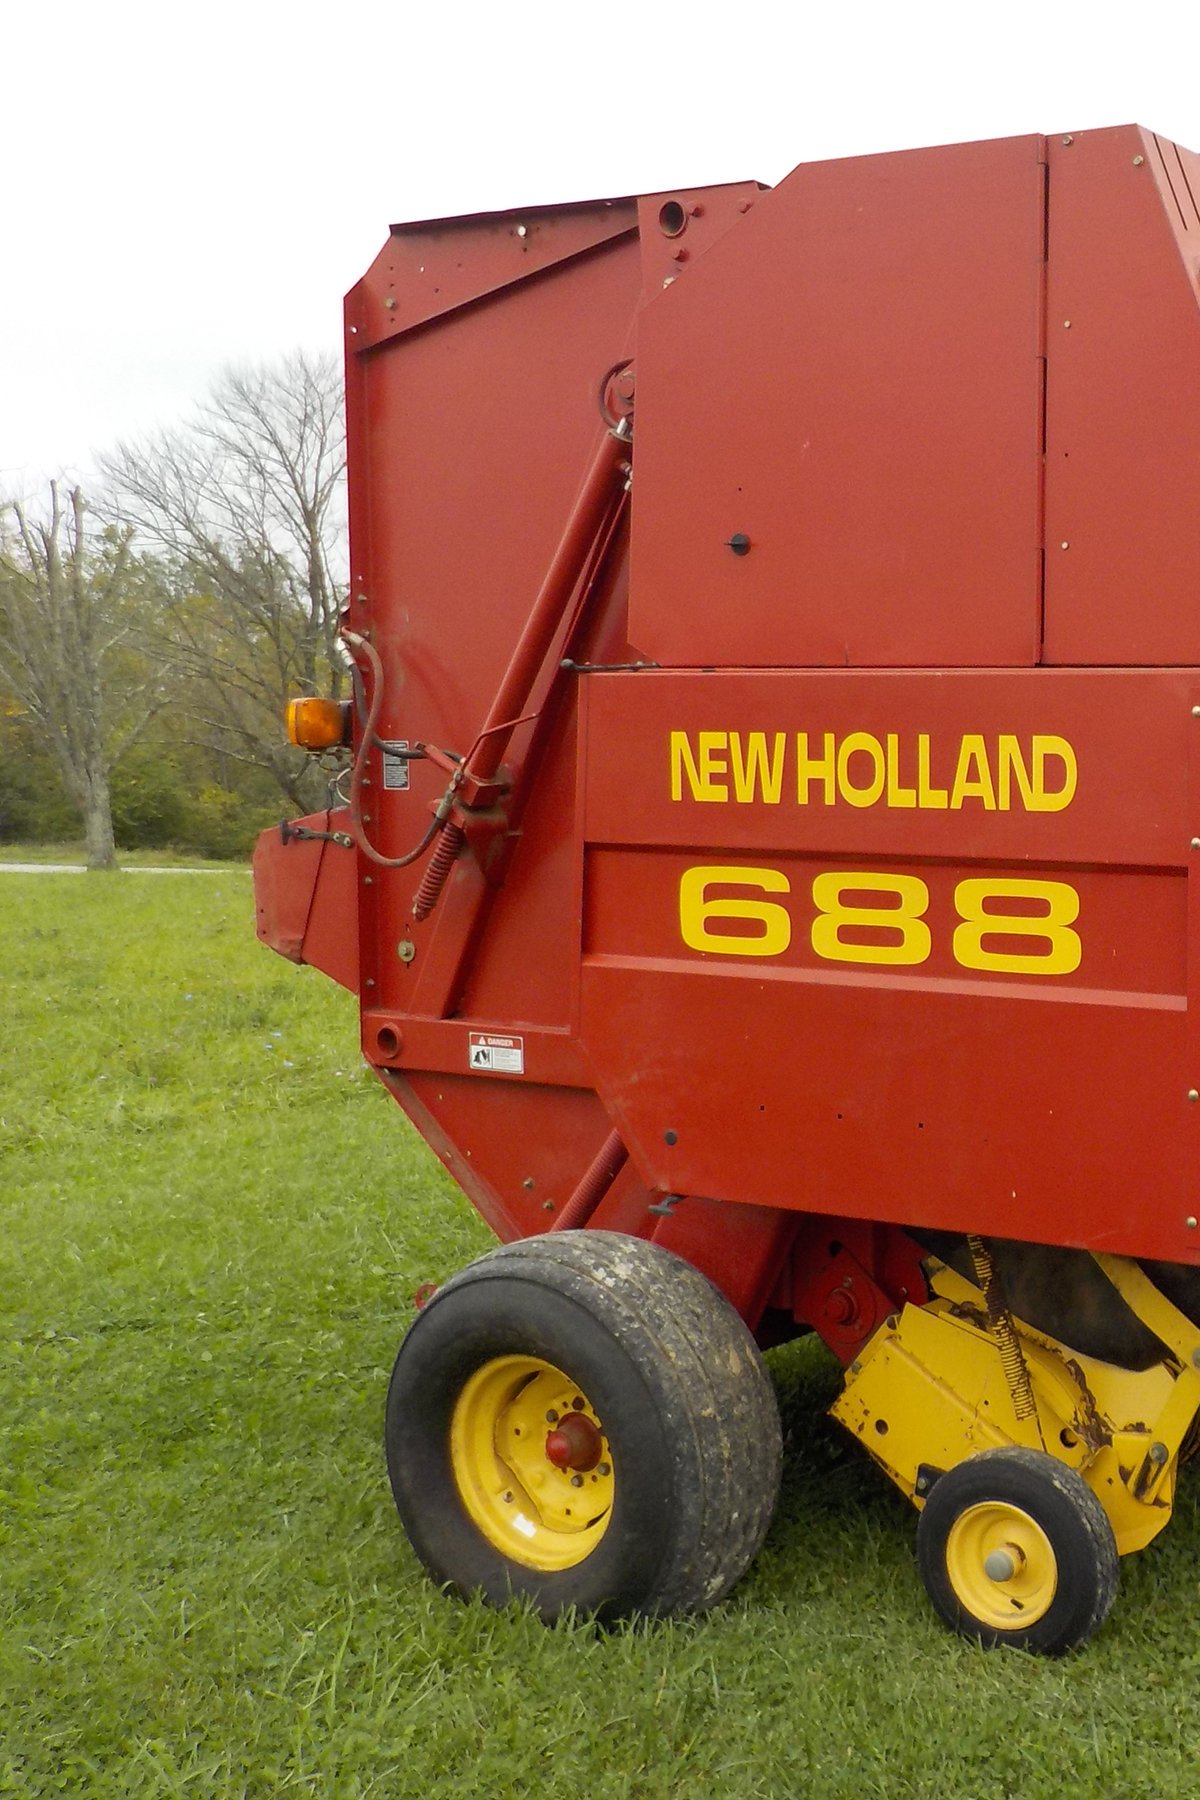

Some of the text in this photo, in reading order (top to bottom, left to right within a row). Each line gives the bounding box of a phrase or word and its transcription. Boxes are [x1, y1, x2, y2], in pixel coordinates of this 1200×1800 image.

[669, 731, 1079, 813] NEW HOLLAND
[679, 865, 1082, 976] 688
[487, 1037, 514, 1047] DANGER
